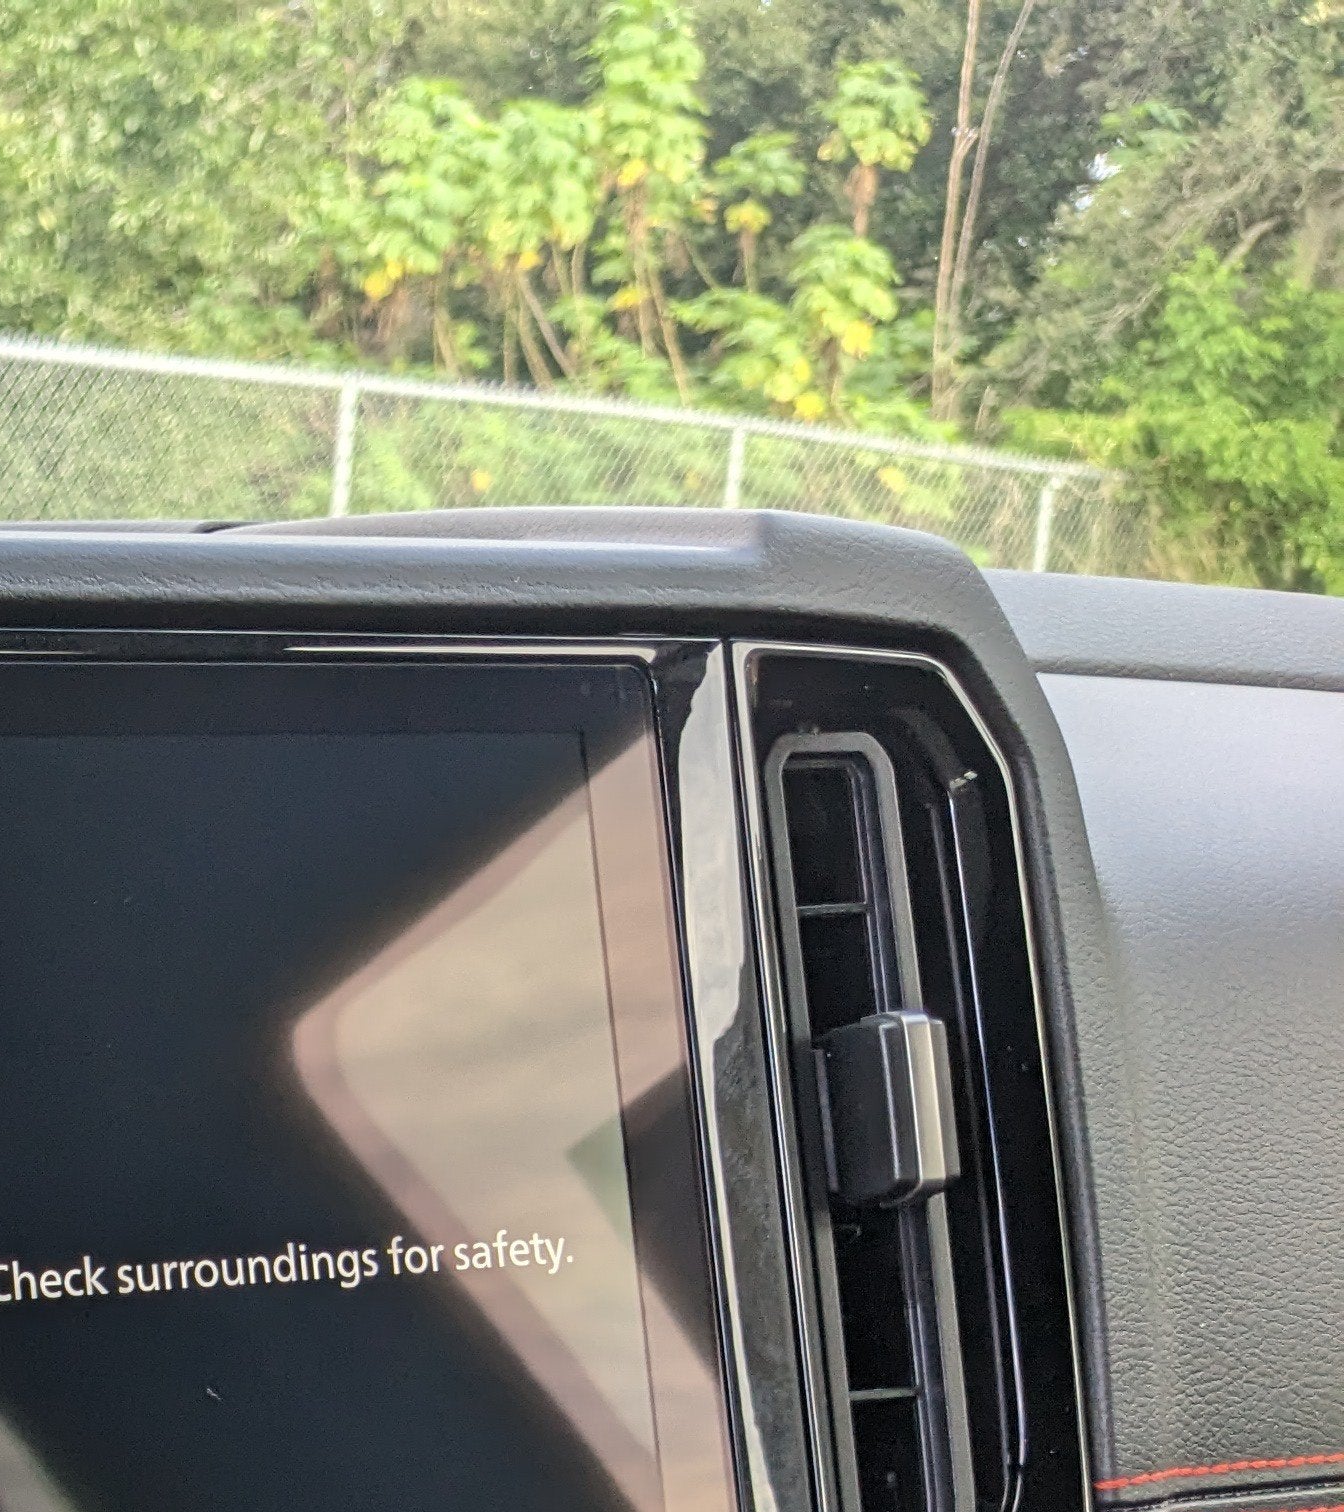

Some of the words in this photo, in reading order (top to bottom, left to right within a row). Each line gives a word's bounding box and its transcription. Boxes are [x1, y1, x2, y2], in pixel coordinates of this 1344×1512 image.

[116, 1242, 379, 1293] surroundings
[386, 1236, 443, 1276] for
[453, 1230, 575, 1275] safety.
